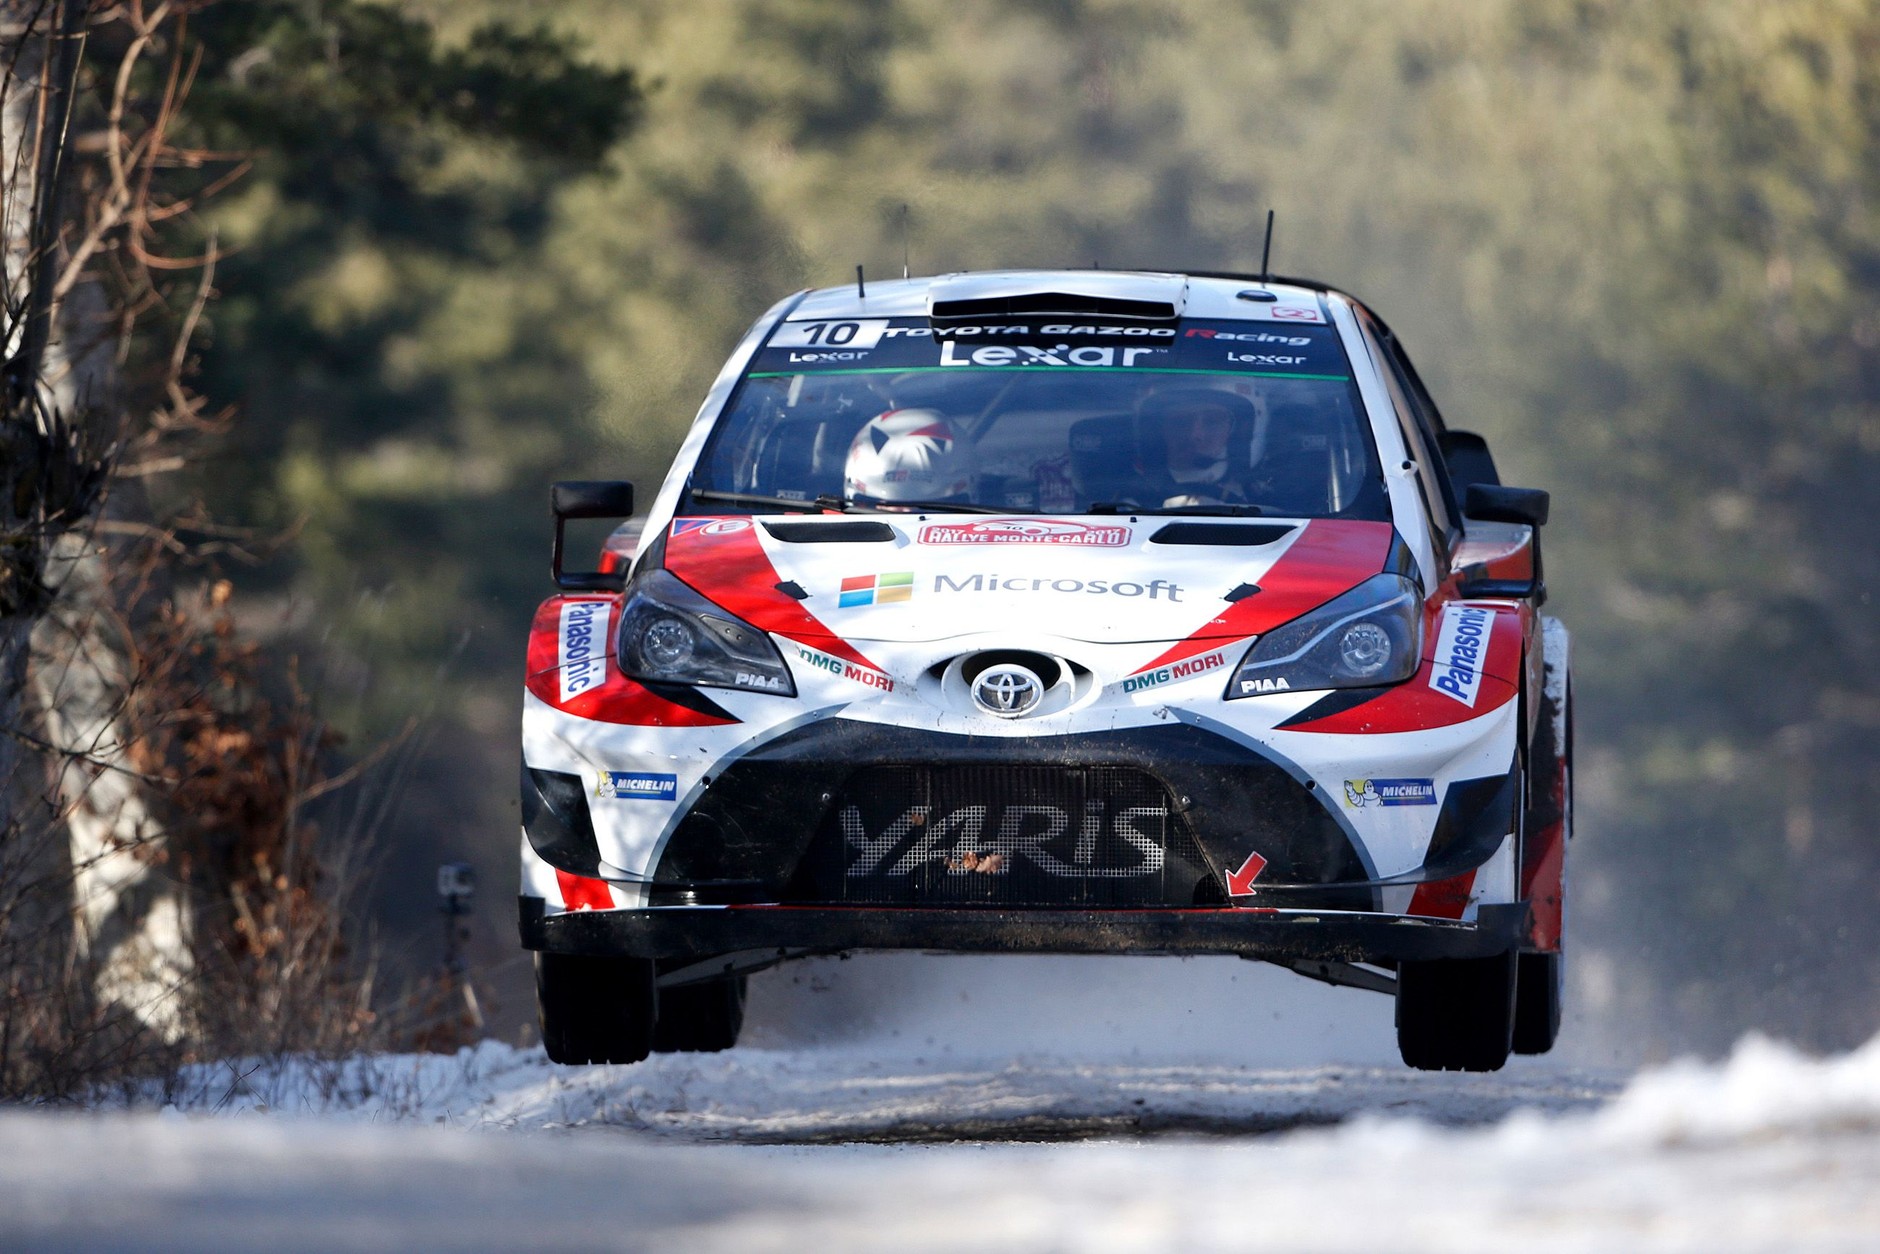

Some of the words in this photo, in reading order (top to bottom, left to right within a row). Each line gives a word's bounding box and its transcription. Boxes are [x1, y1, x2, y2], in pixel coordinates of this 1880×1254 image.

[803, 322, 860, 346] 10
[882, 326, 1029, 338] TOYOTA
[1040, 325, 1176, 337] GAZOO
[1185, 328, 1312, 347] Racing
[789, 351, 869, 363] Lexar
[940, 340, 1153, 367] Lexar
[1227, 351, 1307, 365] Lexar
[928, 532, 988, 544] RALLYE
[993, 532, 1121, 545] MONTE-CARLO
[934, 574, 1184, 602] Microsoft
[566, 602, 605, 692] Panasonic
[1436, 608, 1488, 700] Panasonic
[735, 672, 780, 689] PIAA
[799, 649, 843, 675] DMG
[843, 664, 895, 693] MORI
[1122, 669, 1170, 694] DMG
[1172, 652, 1225, 679] MORI
[1240, 677, 1290, 693] PIAA
[616, 778, 675, 792] MICHELIN
[1382, 785, 1433, 797] MICHELIN
